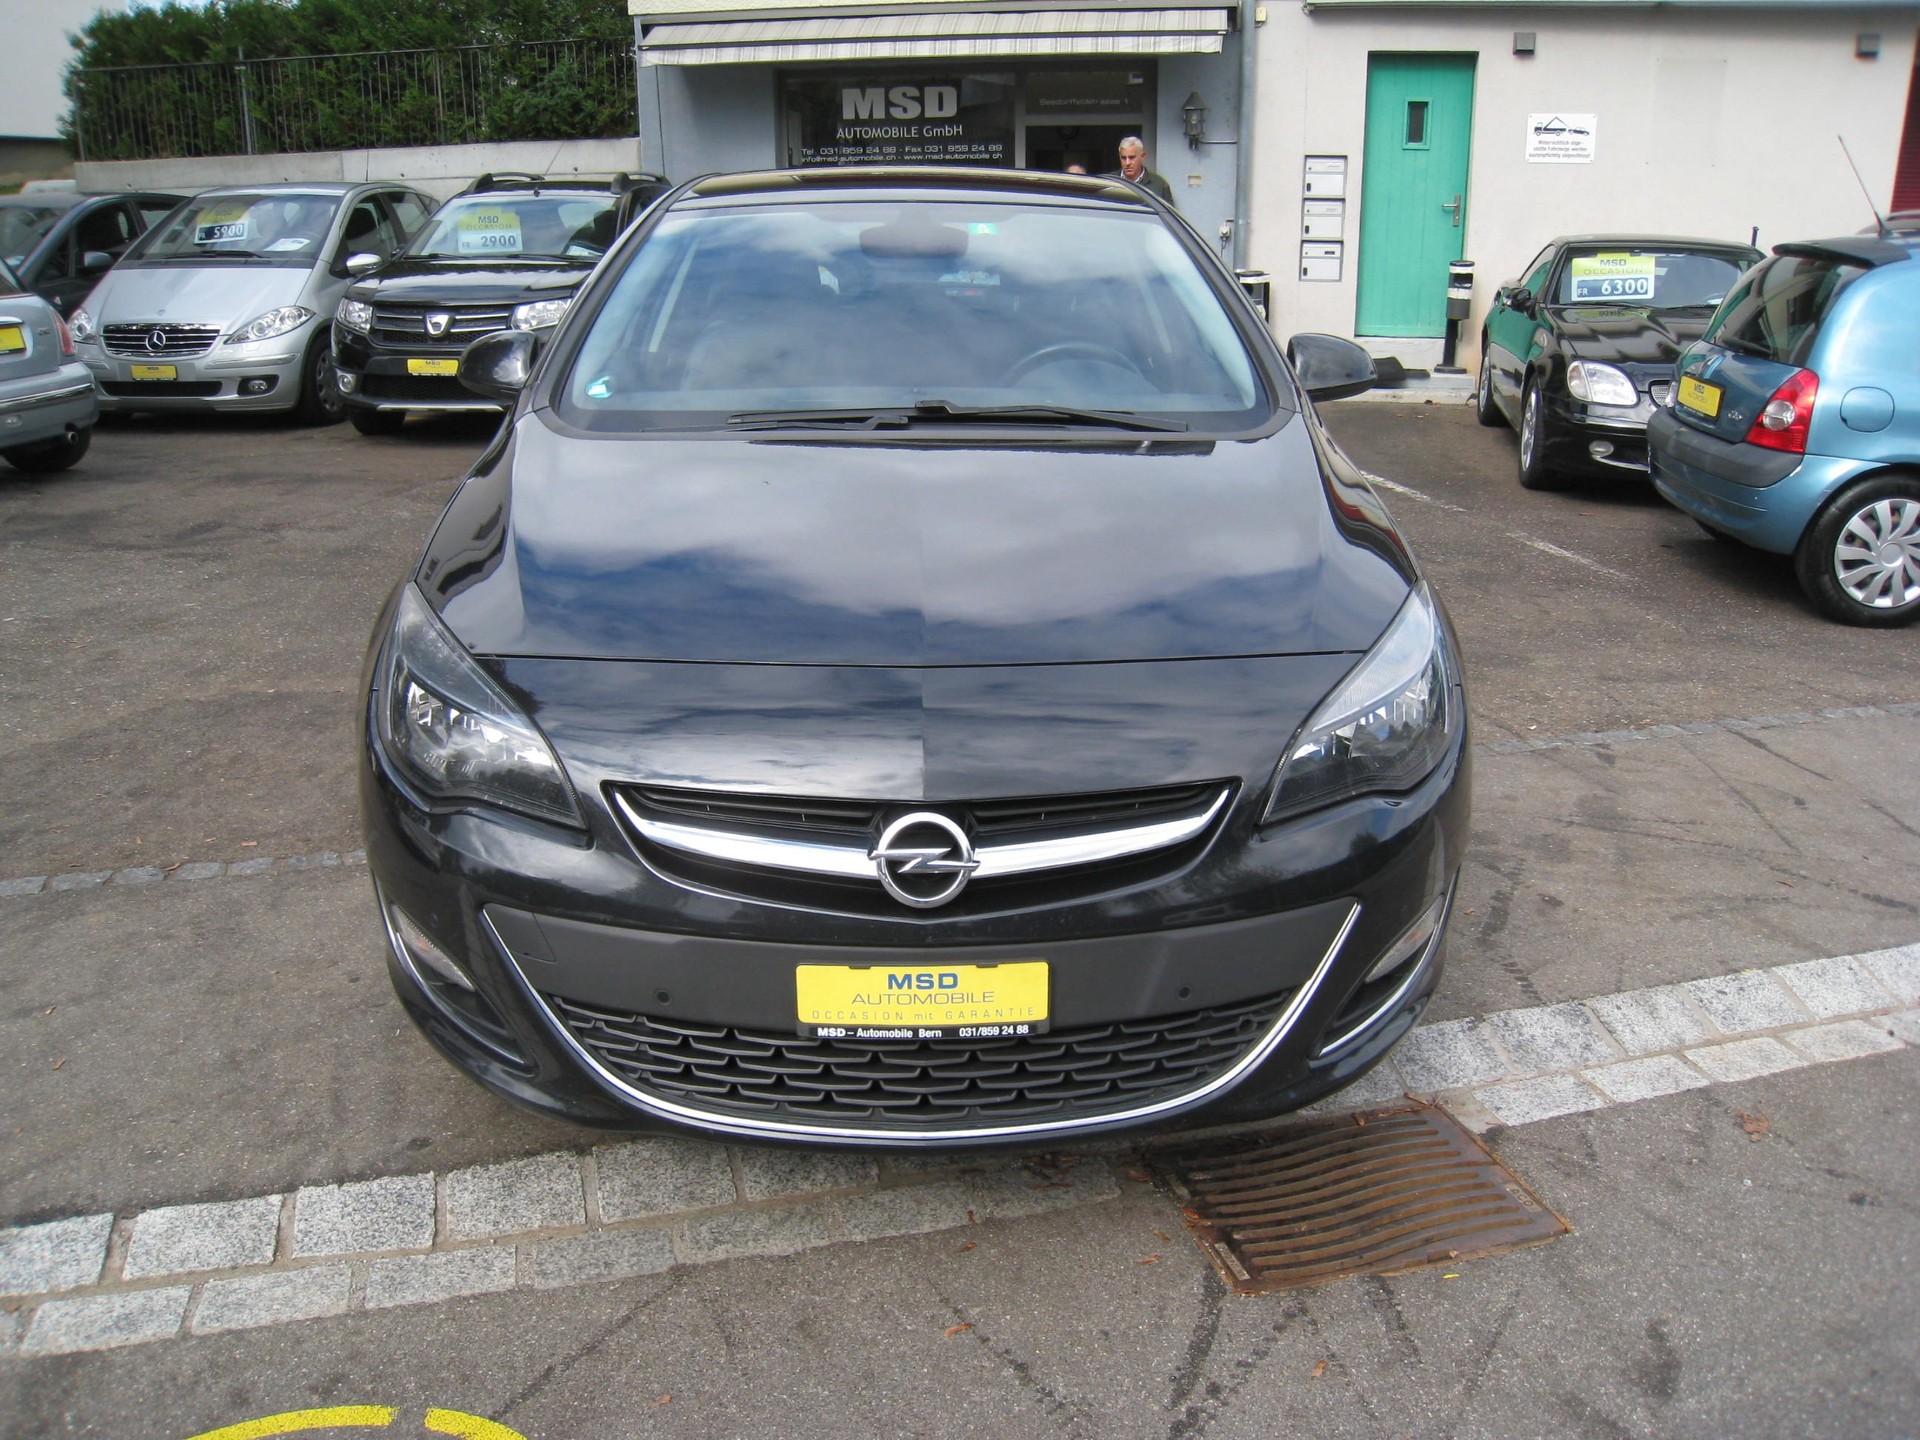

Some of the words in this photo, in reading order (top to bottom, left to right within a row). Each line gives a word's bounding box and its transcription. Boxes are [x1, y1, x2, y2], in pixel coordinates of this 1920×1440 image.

[842, 86, 958, 120] MSD
[836, 127, 919, 138] AUTOMOBILE
[923, 125, 963, 137] GmbH
[866, 146, 880, 154] 24
[924, 145, 943, 153] 031
[971, 144, 985, 152] 24
[478, 216, 499, 224] MSD
[213, 224, 243, 238] 5900
[480, 234, 517, 248] 2900
[1600, 259, 1627, 267] MSD
[1583, 267, 1643, 276] OCCASION
[1577, 288, 1588, 296] FR
[1601, 278, 1648, 295] 6300
[888, 973, 959, 990] MSD
[851, 991, 995, 1005] AUTOMOBILE
[812, 1010, 904, 1021] OCCASION
[914, 1011, 934, 1020] mit
[946, 1006, 1034, 1020] GARANTIE
[856, 1027, 913, 1038] Automobile
[918, 1028, 942, 1038] Bern
[959, 1025, 1000, 1037] 031/859
[1001, 1025, 1015, 1036] 24
[1016, 1025, 1029, 1035] 88
